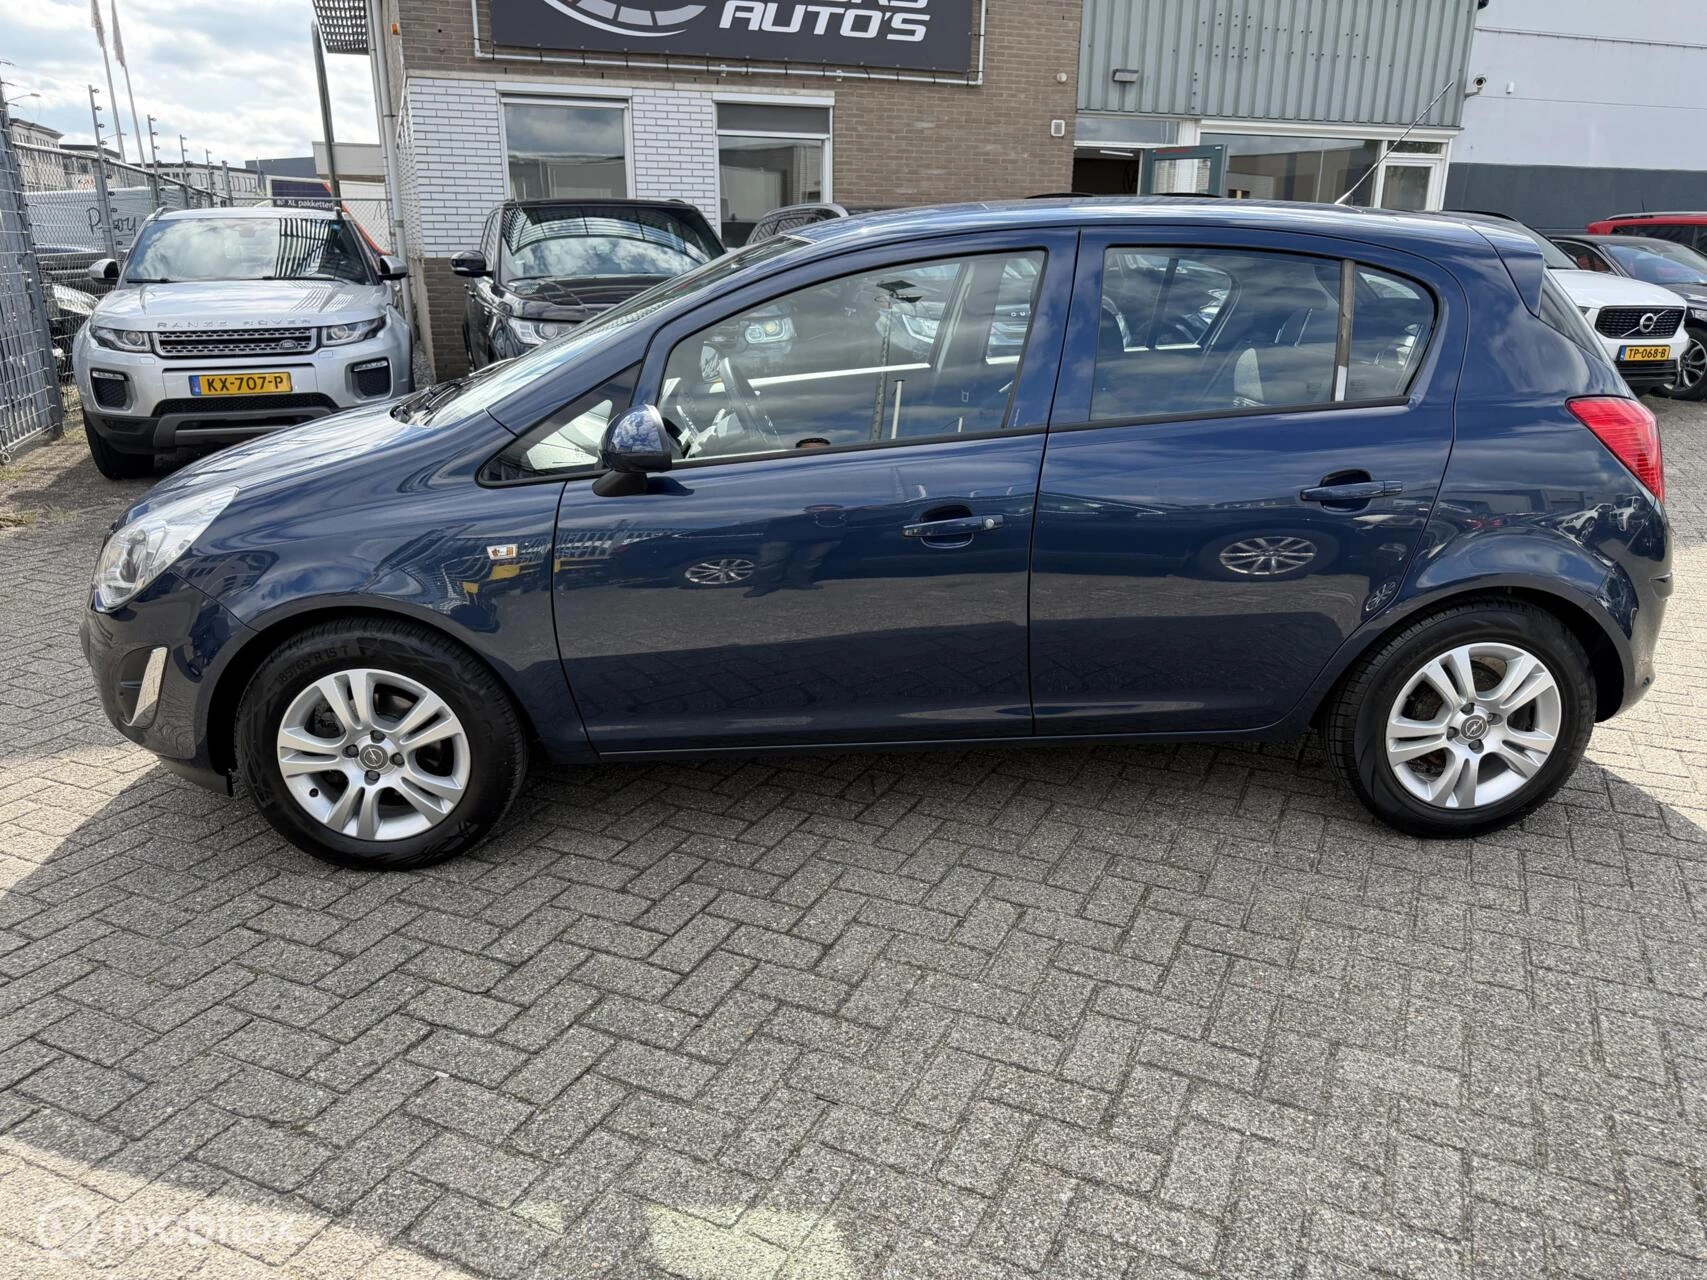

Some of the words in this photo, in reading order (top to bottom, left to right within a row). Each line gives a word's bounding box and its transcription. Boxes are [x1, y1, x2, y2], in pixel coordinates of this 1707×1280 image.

[719, 0, 931, 42] AUTO'S
[243, 318, 312, 326] ROVER
[1628, 348, 1667, 359] TP-068-B
[206, 375, 284, 392] KX-707-P
